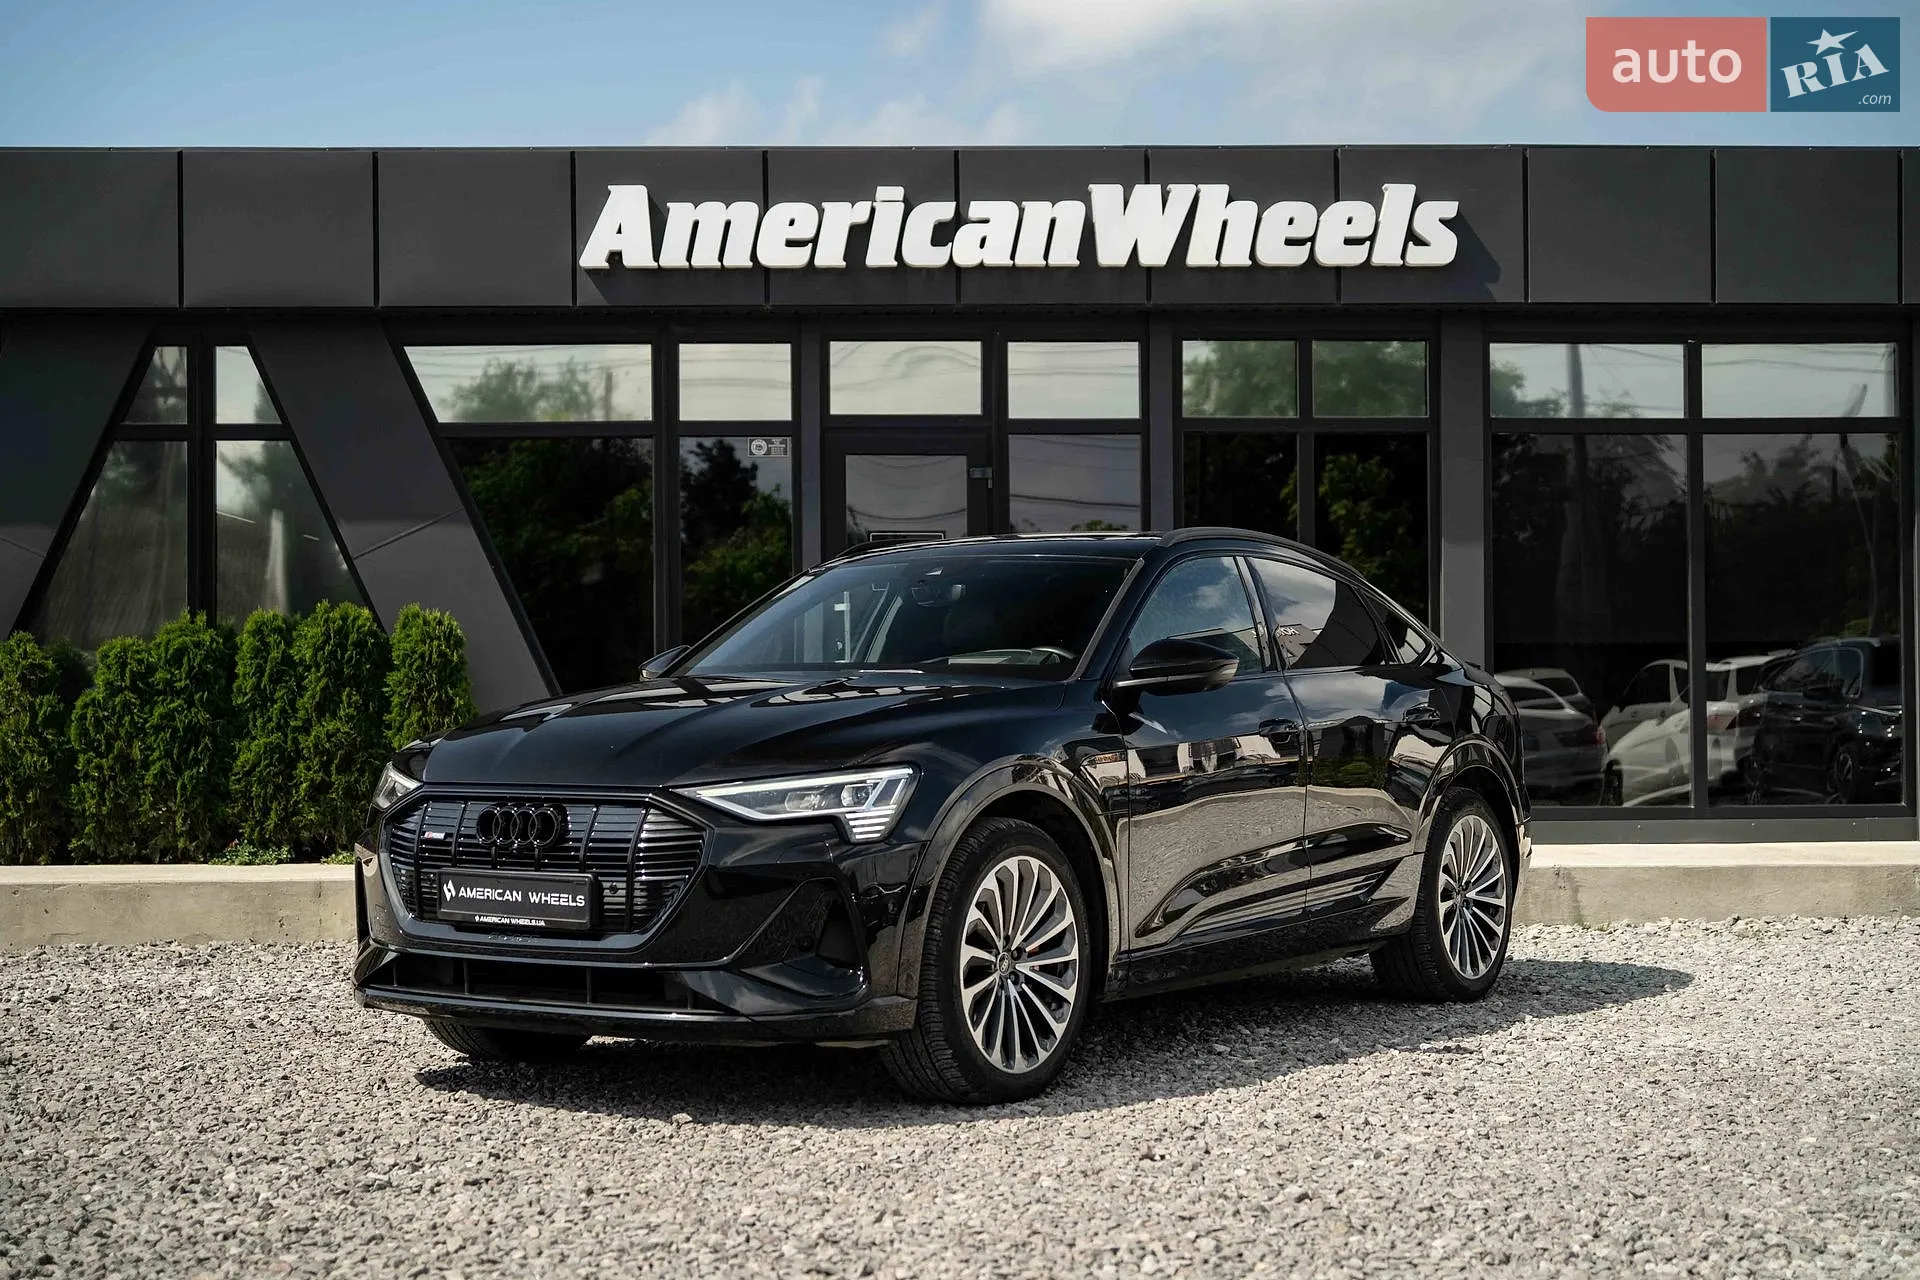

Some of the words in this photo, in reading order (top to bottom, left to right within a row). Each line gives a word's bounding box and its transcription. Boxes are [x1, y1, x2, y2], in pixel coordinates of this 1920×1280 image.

[579, 184, 1459, 268] AmericanWheels
[458, 886, 522, 903] AMERICAN
[528, 891, 586, 907] WHEELS
[479, 915, 510, 924] AMERICAN
[510, 917, 546, 927] WHEELS.UA
